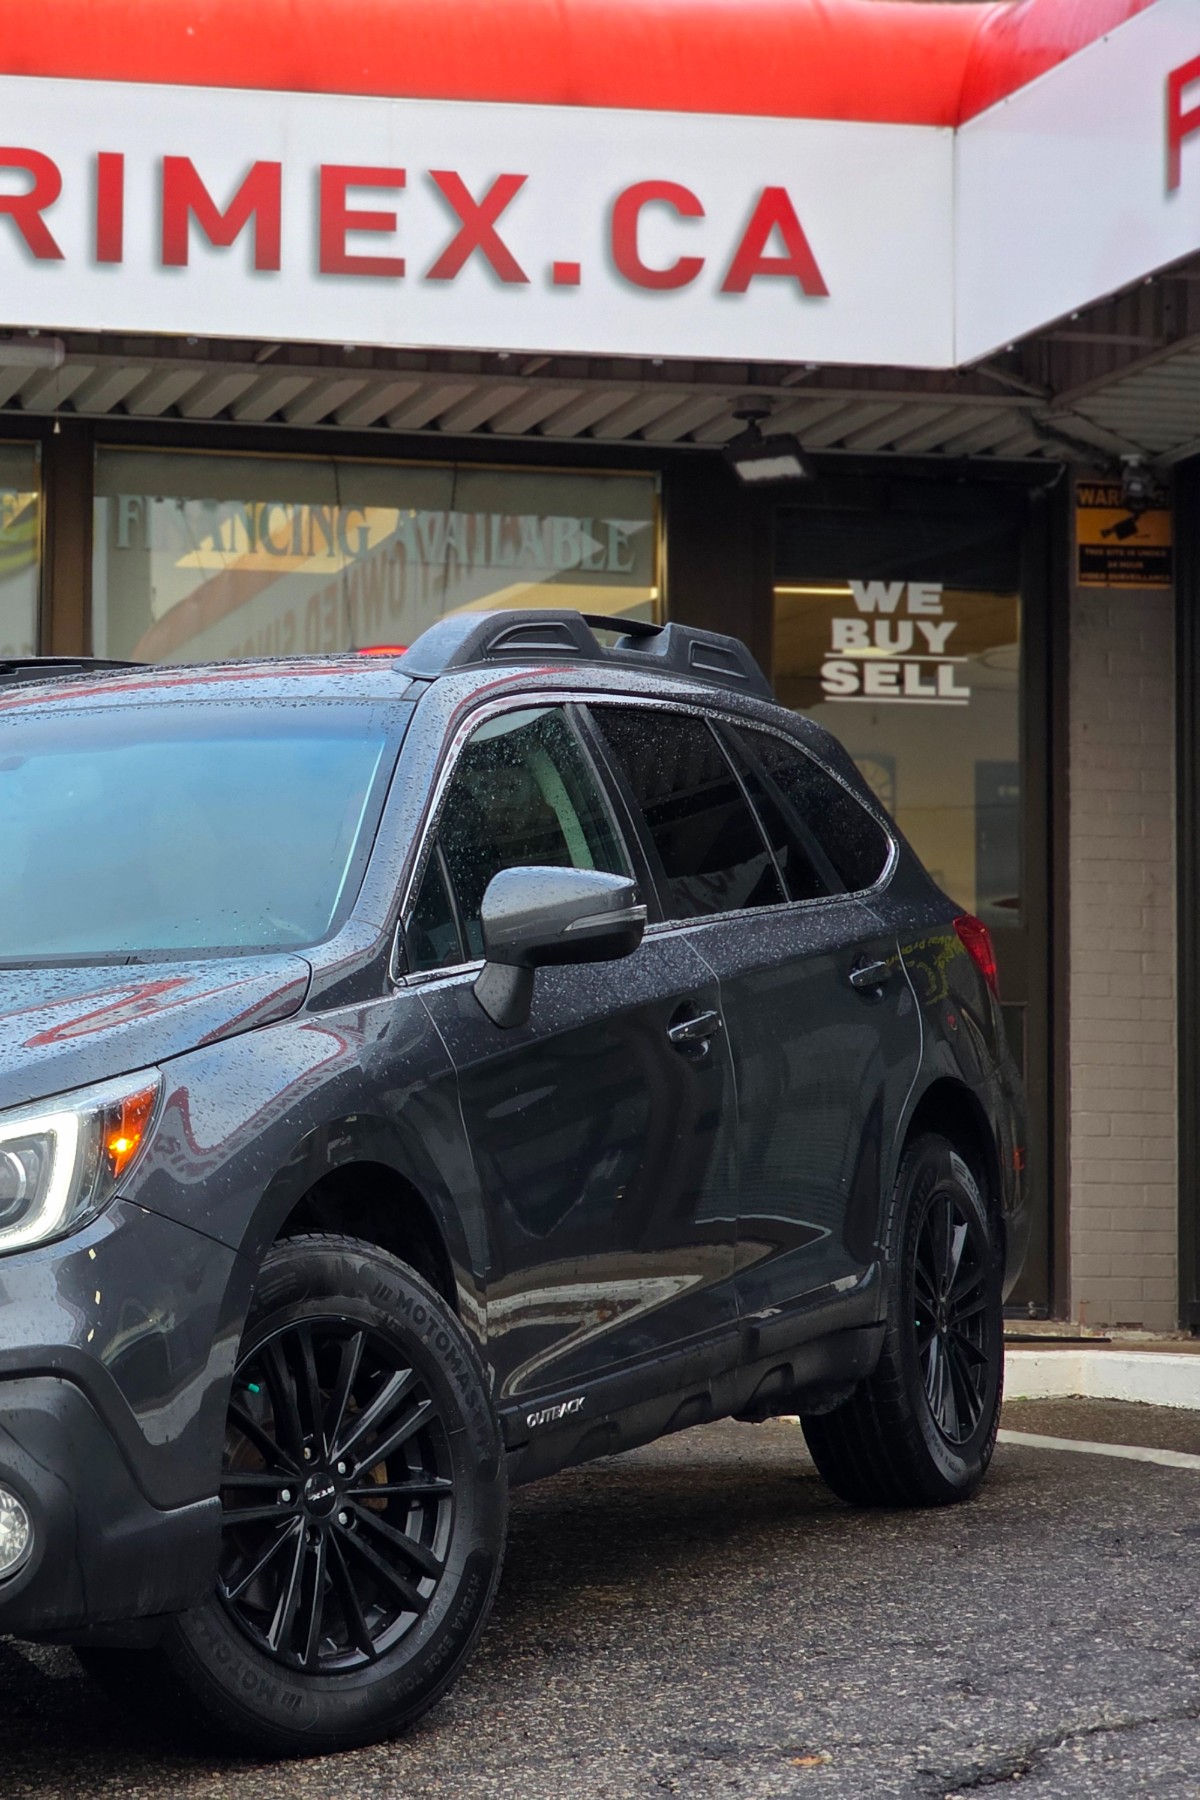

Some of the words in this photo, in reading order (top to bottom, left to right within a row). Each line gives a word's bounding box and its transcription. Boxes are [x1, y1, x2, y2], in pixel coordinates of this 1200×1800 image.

[115, 494, 371, 561] FINANCING
[394, 508, 635, 573] AVAILABLE
[848, 580, 944, 615] WE
[831, 618, 958, 654] BUY
[820, 660, 971, 697] SELL
[526, 1396, 586, 1428] OUTBACK
